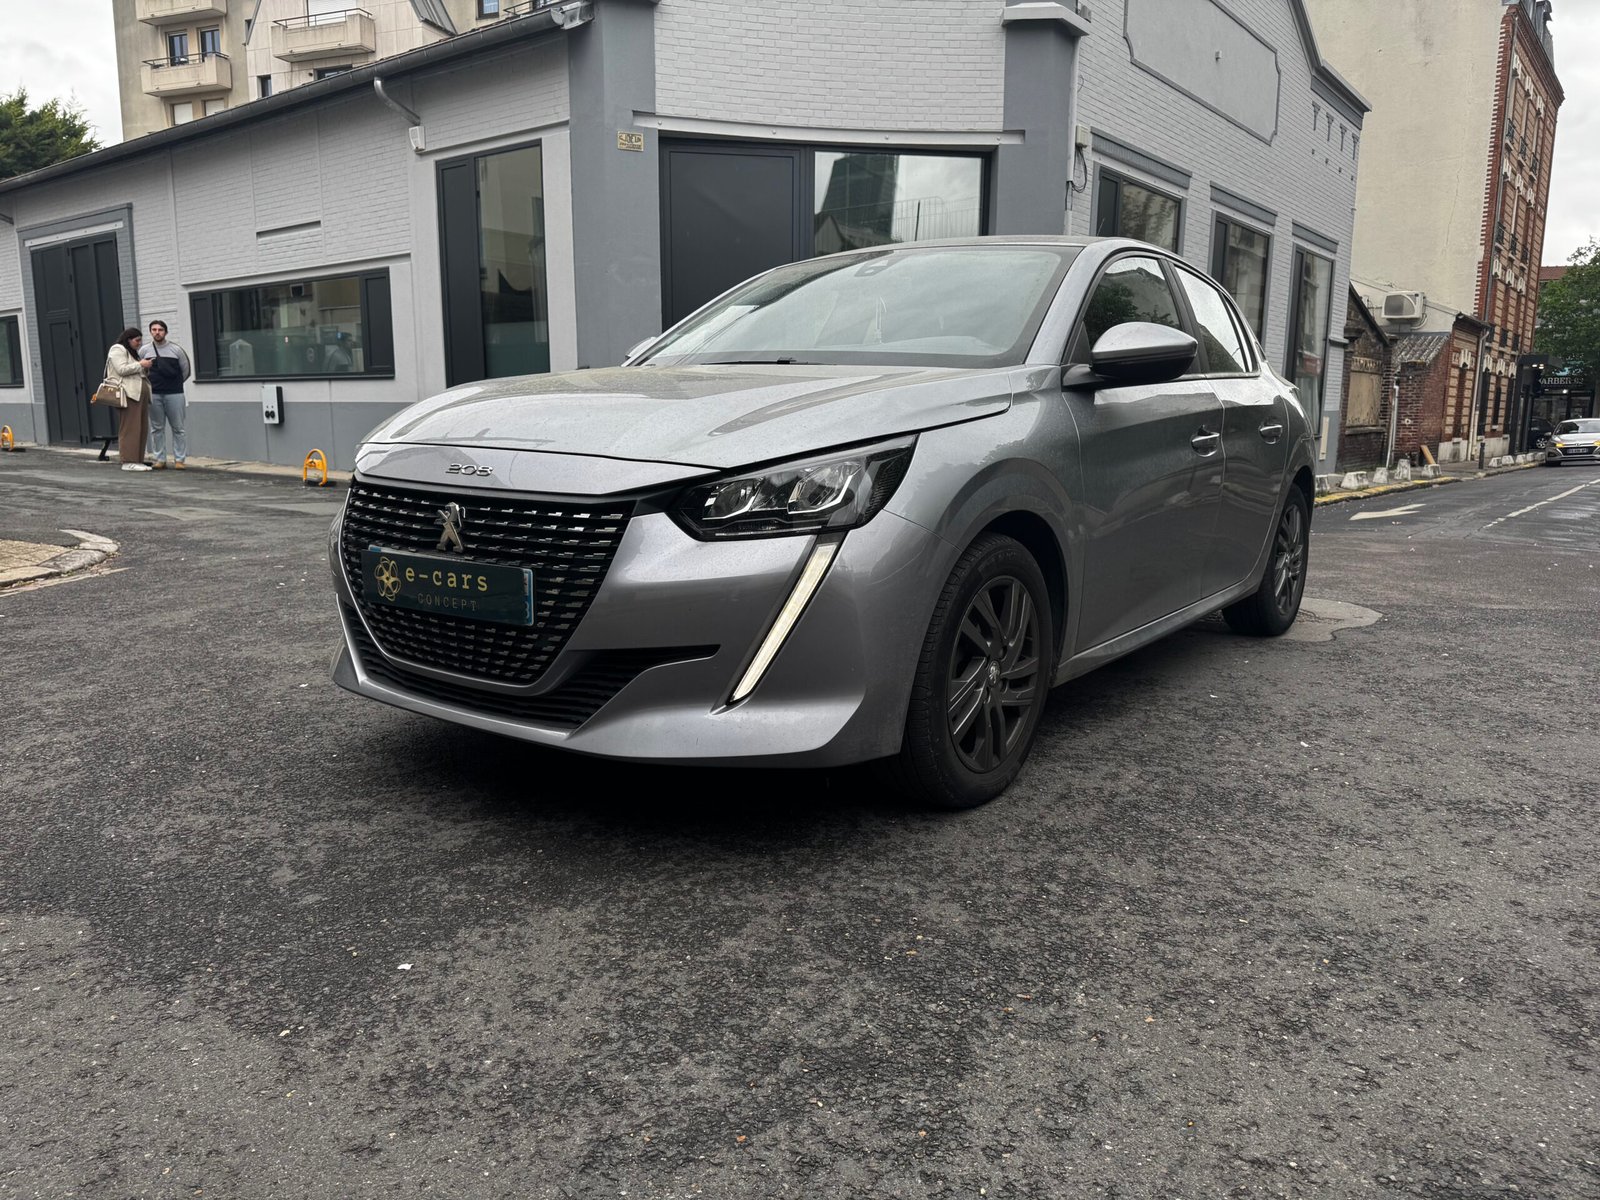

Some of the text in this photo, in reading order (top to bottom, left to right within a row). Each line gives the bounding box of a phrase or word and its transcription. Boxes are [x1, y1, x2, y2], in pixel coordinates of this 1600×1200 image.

[1539, 377, 1572, 385] ARBER
[446, 463, 493, 476] 208
[406, 568, 488, 591] e-cars
[418, 593, 478, 611] CONCEPT
